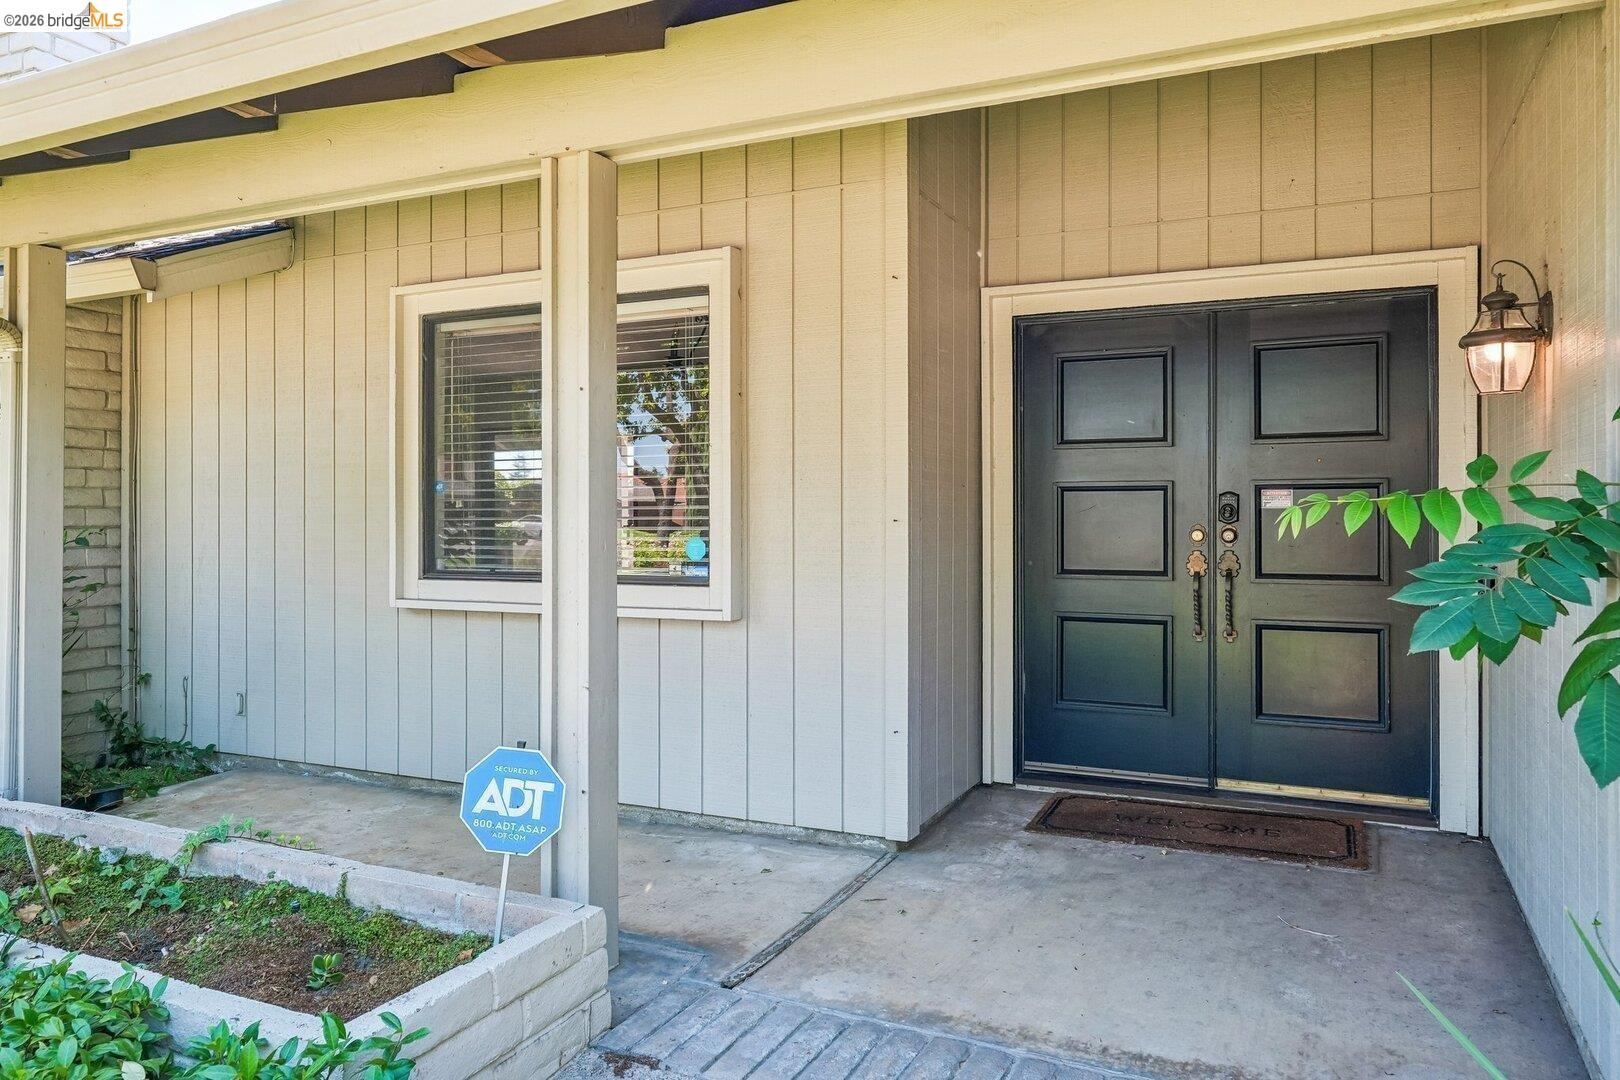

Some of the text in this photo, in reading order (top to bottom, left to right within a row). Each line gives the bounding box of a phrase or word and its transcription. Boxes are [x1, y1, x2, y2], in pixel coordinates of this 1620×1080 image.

[494, 765, 528, 775] SECURED
[472, 777, 555, 820] ADT
[473, 819, 547, 835] 800.ADT.ASAP
[1115, 813, 1281, 838] WELCOME
[491, 831, 526, 841] ADT.COM
